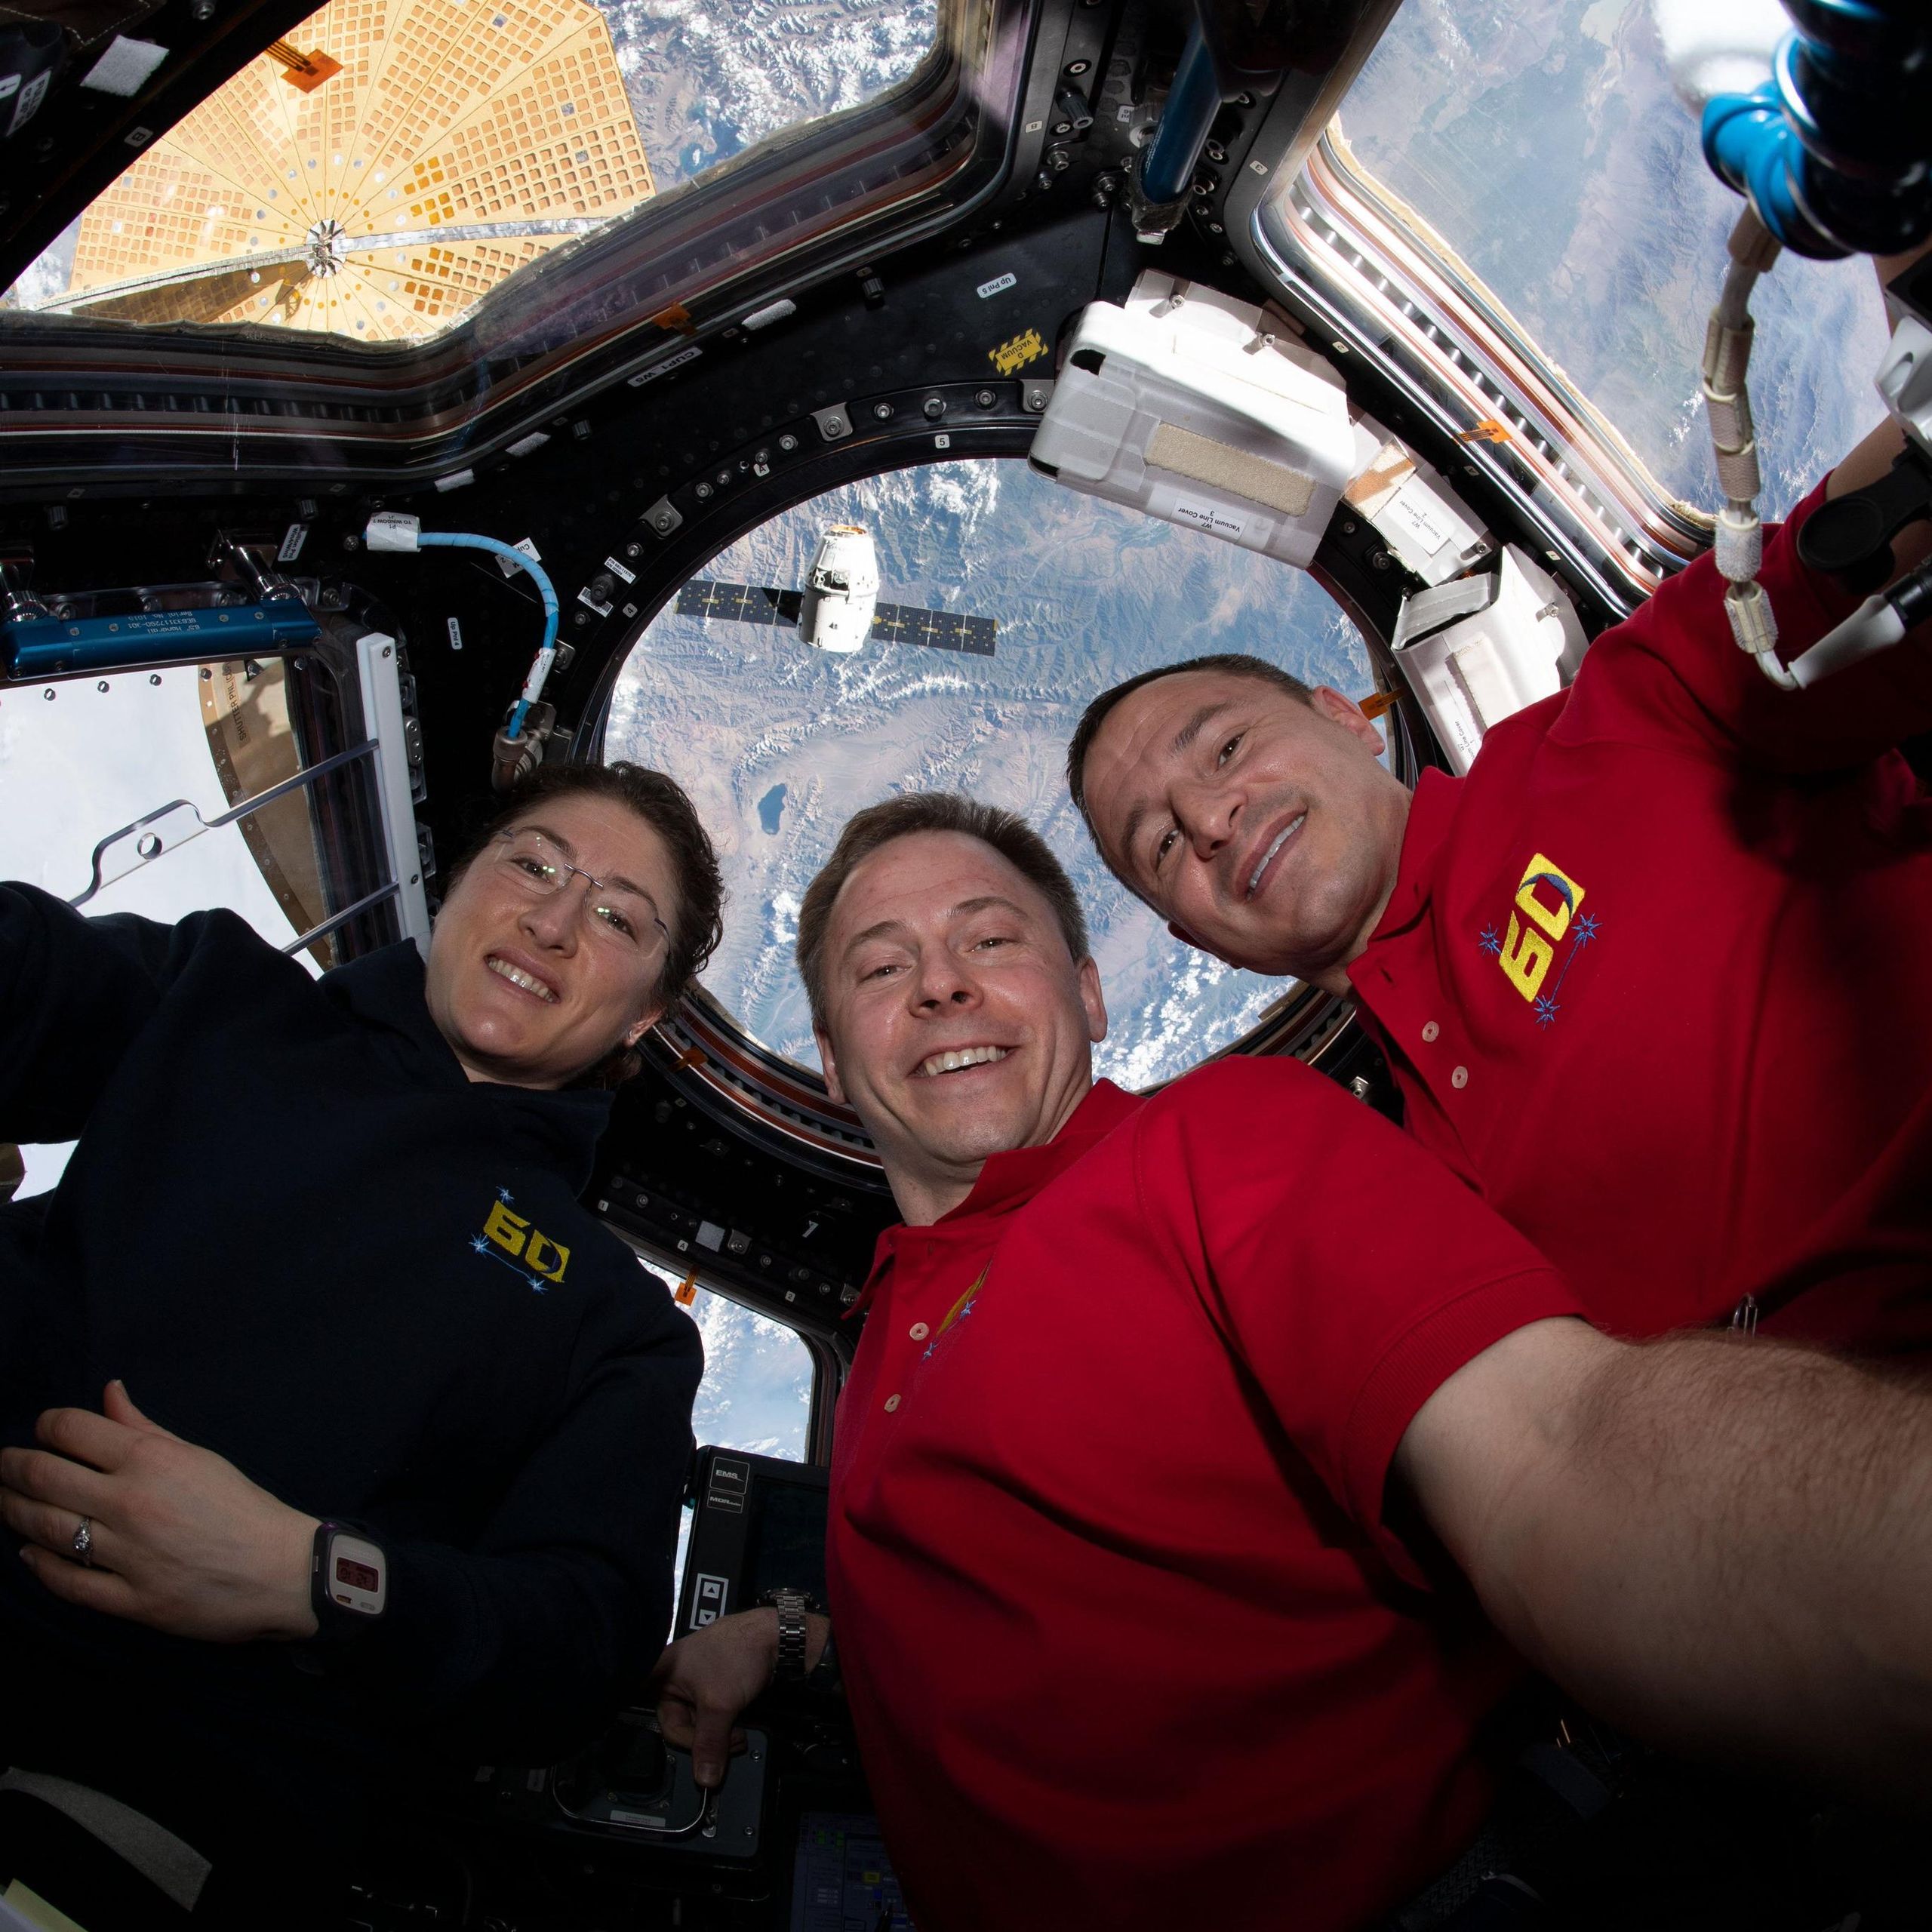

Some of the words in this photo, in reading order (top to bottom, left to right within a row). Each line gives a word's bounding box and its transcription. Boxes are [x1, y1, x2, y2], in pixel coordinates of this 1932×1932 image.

[1000, 276, 1011, 285] Up
[1001, 339, 1032, 359] VACUUM
[939, 438, 946, 446] 5
[1178, 507, 1198, 518] Cover
[1399, 500, 1414, 513] Cover
[1199, 514, 1213, 524] Line
[1413, 512, 1423, 523] Line
[1214, 518, 1240, 532] Vacuum
[1423, 521, 1441, 540] Vacuum
[147, 626, 182, 634] Handrail
[450, 621, 457, 630] Up
[227, 681, 236, 700] PNL
[230, 701, 247, 741] SHUTTER
[1455, 721, 1465, 737] Cover
[1498, 853, 1586, 1003] 60
[483, 1200, 570, 1282] 60
[715, 1469, 738, 1479] EMS
